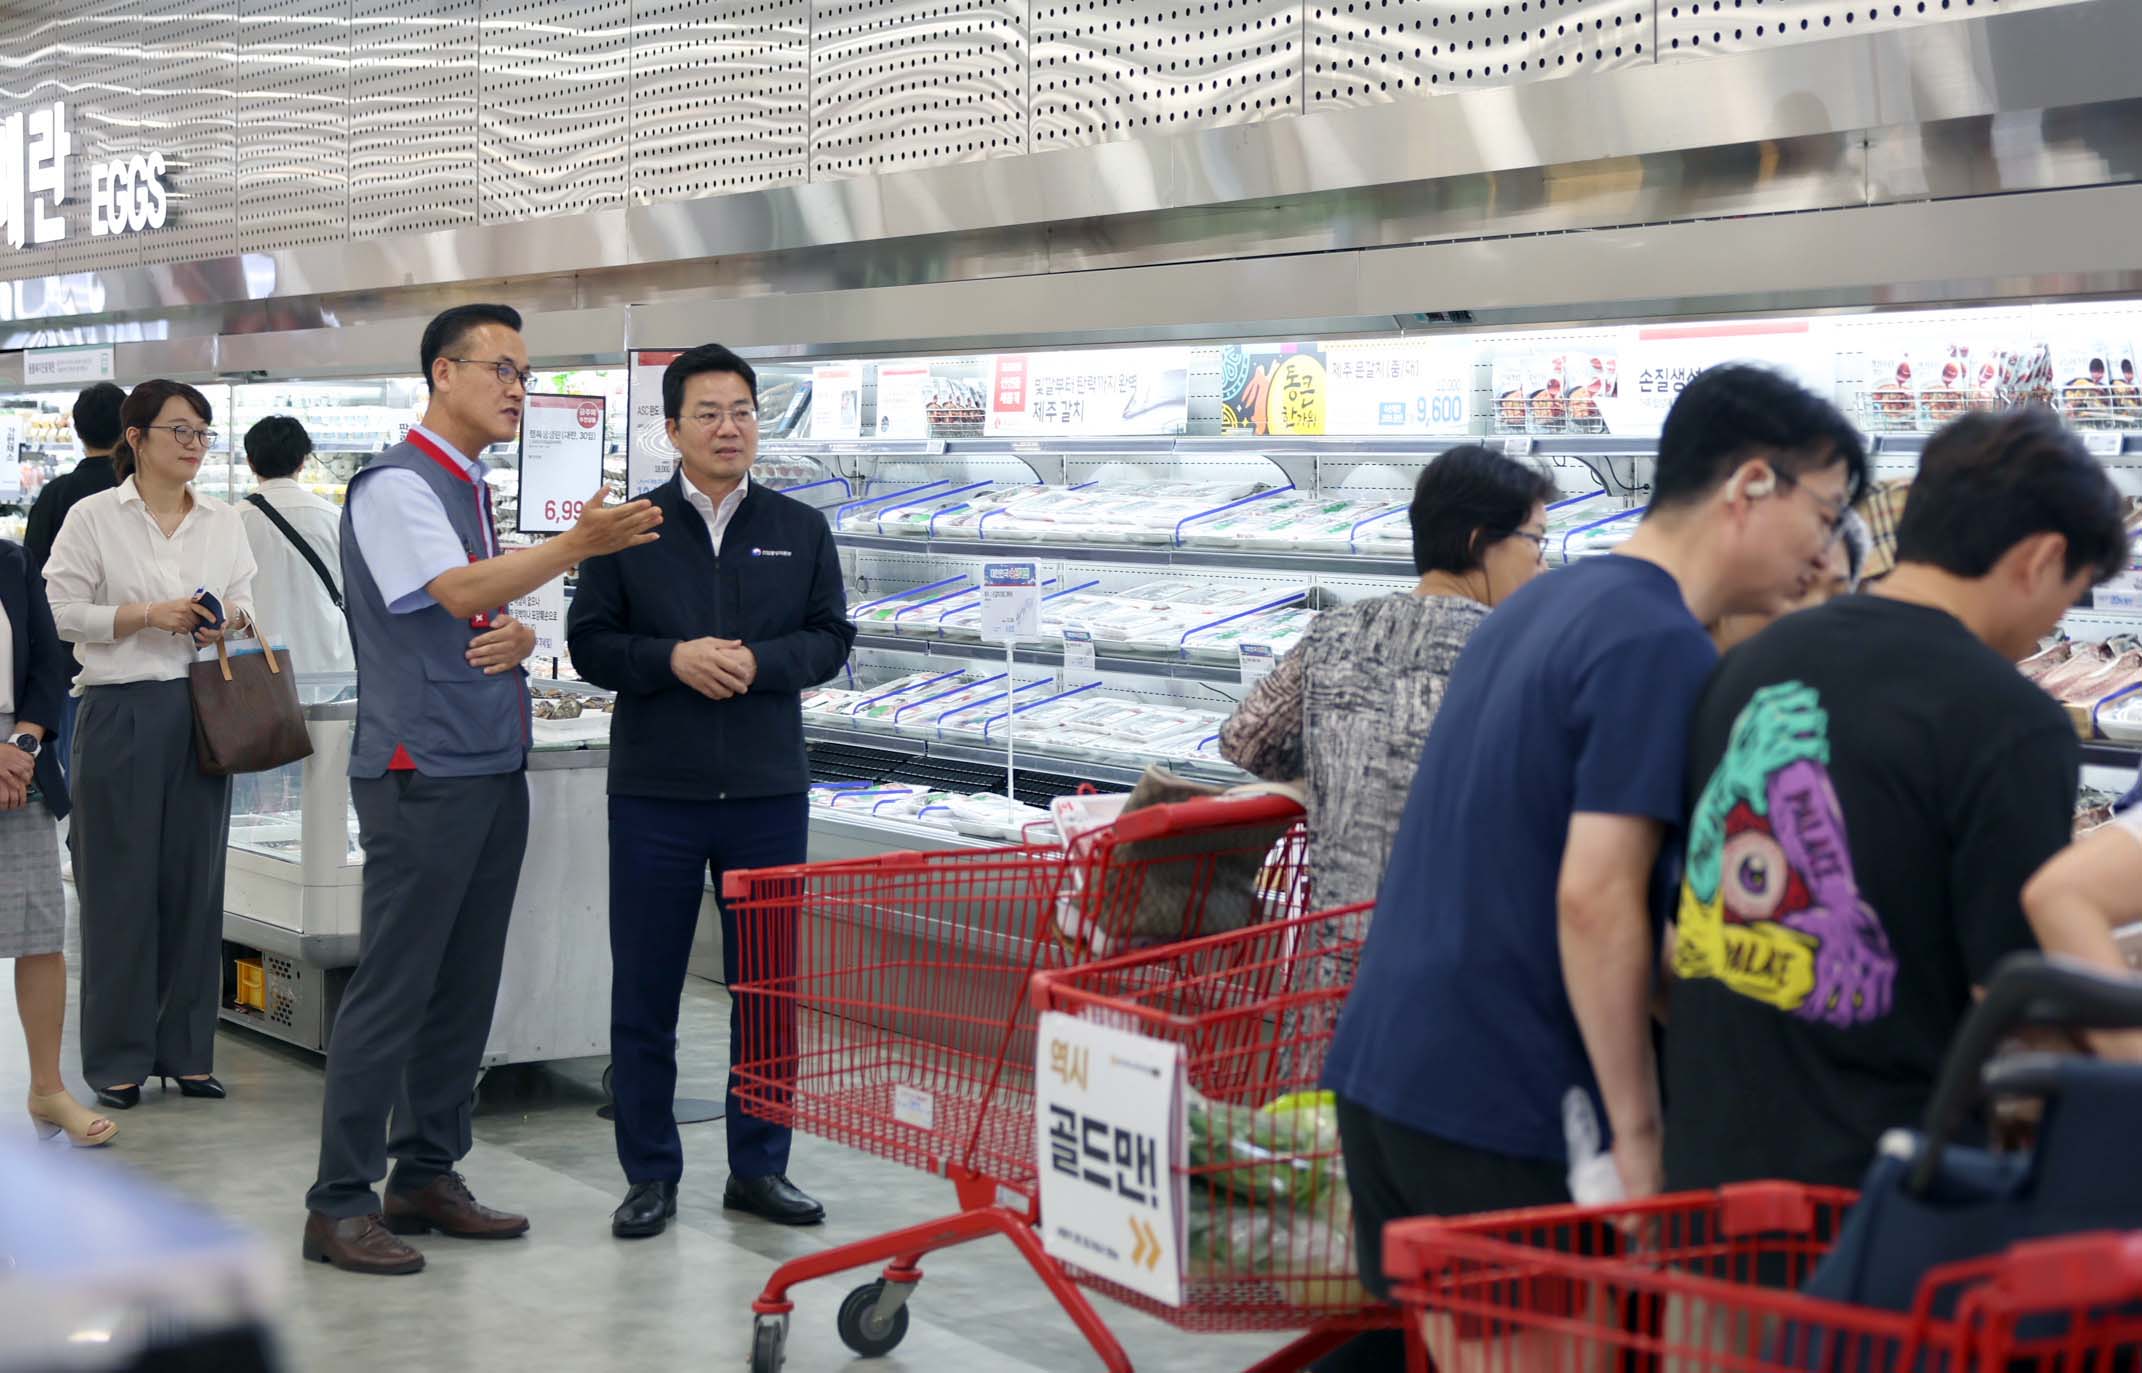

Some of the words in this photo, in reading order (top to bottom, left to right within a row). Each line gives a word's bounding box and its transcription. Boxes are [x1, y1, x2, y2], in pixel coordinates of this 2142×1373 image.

[91, 150, 167, 236] EGGS
[1283, 364, 1316, 409] 통큰
[1033, 400, 1057, 423] 제주
[1060, 400, 1085, 423] 갈치
[1281, 406, 1317, 429] 한가위
[1416, 395, 1462, 427] 9,600
[544, 499, 585, 524] 6,99
[1051, 1039, 1090, 1091] 역시
[1050, 1103, 1159, 1209] 골드맨!
